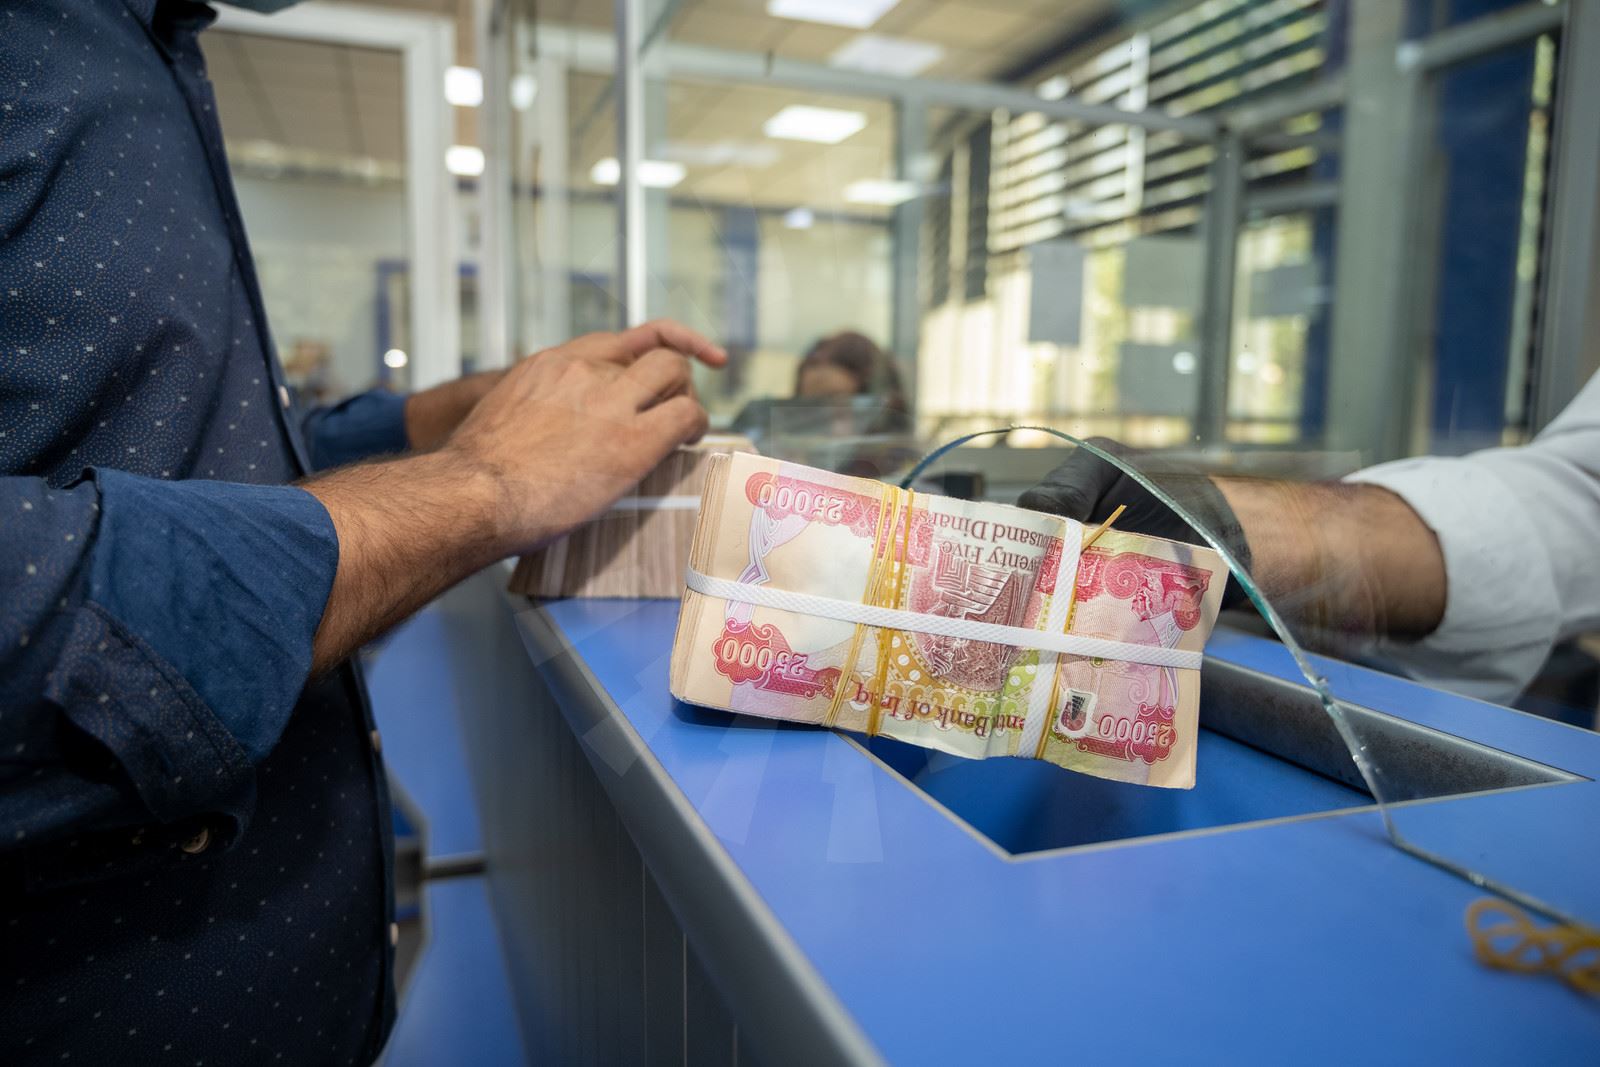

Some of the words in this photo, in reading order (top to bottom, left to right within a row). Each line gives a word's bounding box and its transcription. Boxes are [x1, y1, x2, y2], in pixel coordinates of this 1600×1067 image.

[757, 480, 845, 521] 25000
[918, 511, 988, 541] Dinars
[941, 540, 985, 565] Five
[988, 545, 1041, 573] wenty
[721, 636, 808, 677] 25000
[904, 700, 931, 721] of
[935, 705, 989, 738] Bank
[1098, 714, 1172, 748] 25000
